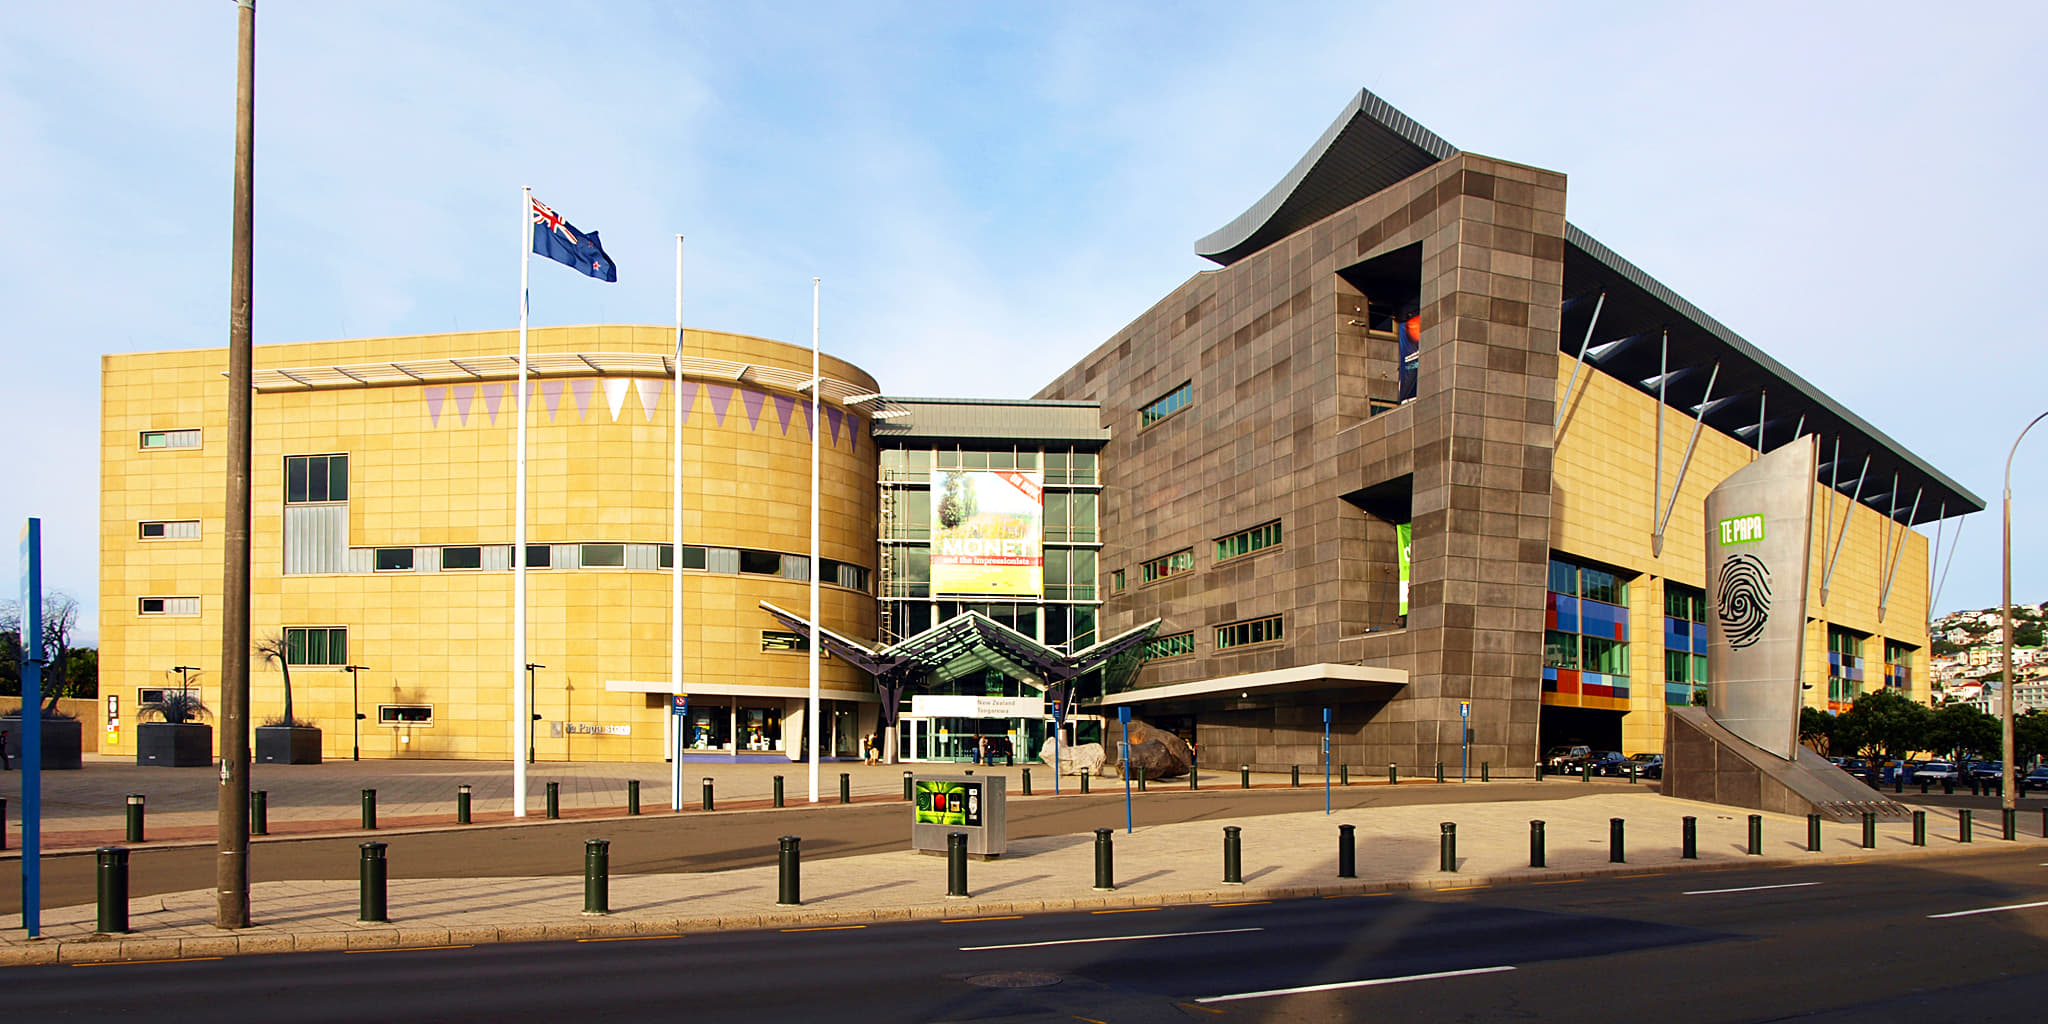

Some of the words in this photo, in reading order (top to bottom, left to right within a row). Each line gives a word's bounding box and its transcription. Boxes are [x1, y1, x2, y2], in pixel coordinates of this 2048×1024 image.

[1720, 520, 1733, 544] TE
[1733, 516, 1762, 542] PAPA
[942, 538, 1029, 557] MONET
[943, 556, 958, 564] and
[579, 723, 602, 735] Papa
